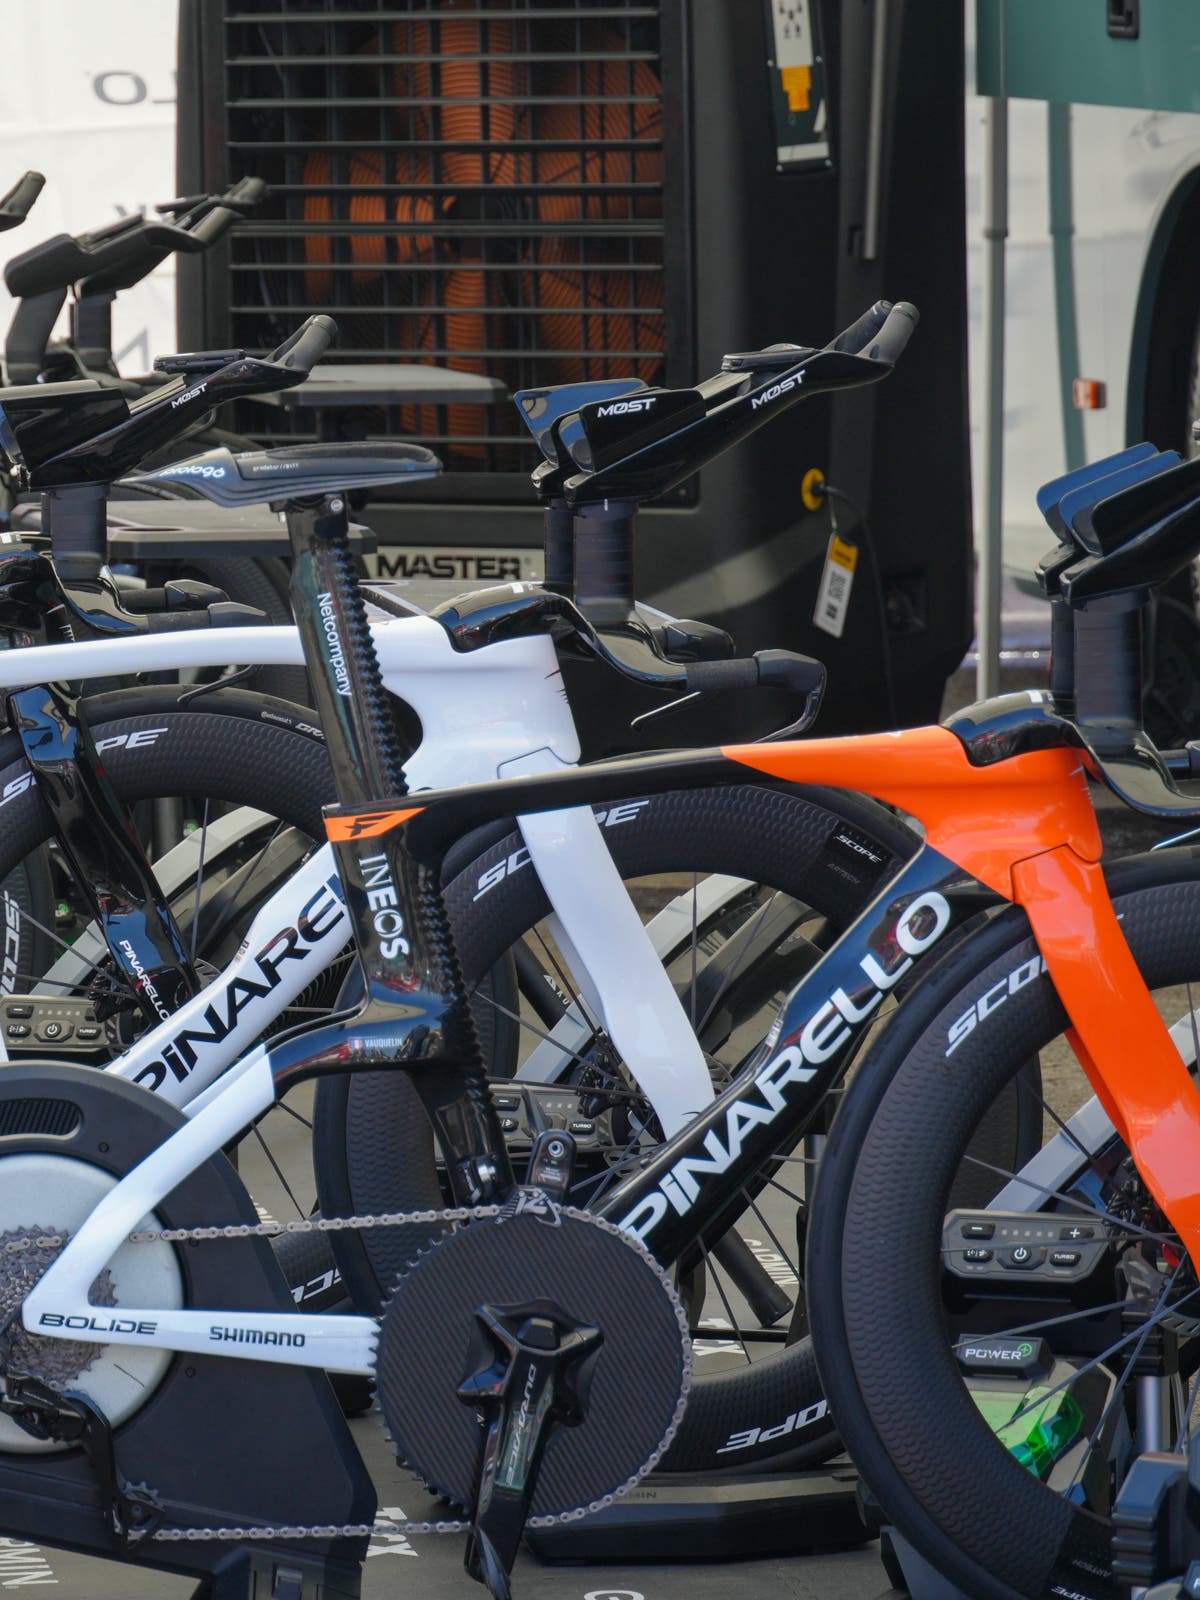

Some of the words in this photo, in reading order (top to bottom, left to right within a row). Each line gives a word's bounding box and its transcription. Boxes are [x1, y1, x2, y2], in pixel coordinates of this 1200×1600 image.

[377, 555, 521, 581] MASTER
[316, 592, 352, 697] Netcompany
[834, 834, 882, 863] SCOPE
[357, 852, 410, 960] INEOS
[119, 939, 171, 1022] PINARELLO
[364, 1037, 403, 1048] VAUQUELIN
[618, 891, 952, 1249] PINARELLO
[38, 1312, 159, 1336] BOLIDE
[209, 1326, 306, 1348] SHIMANO
